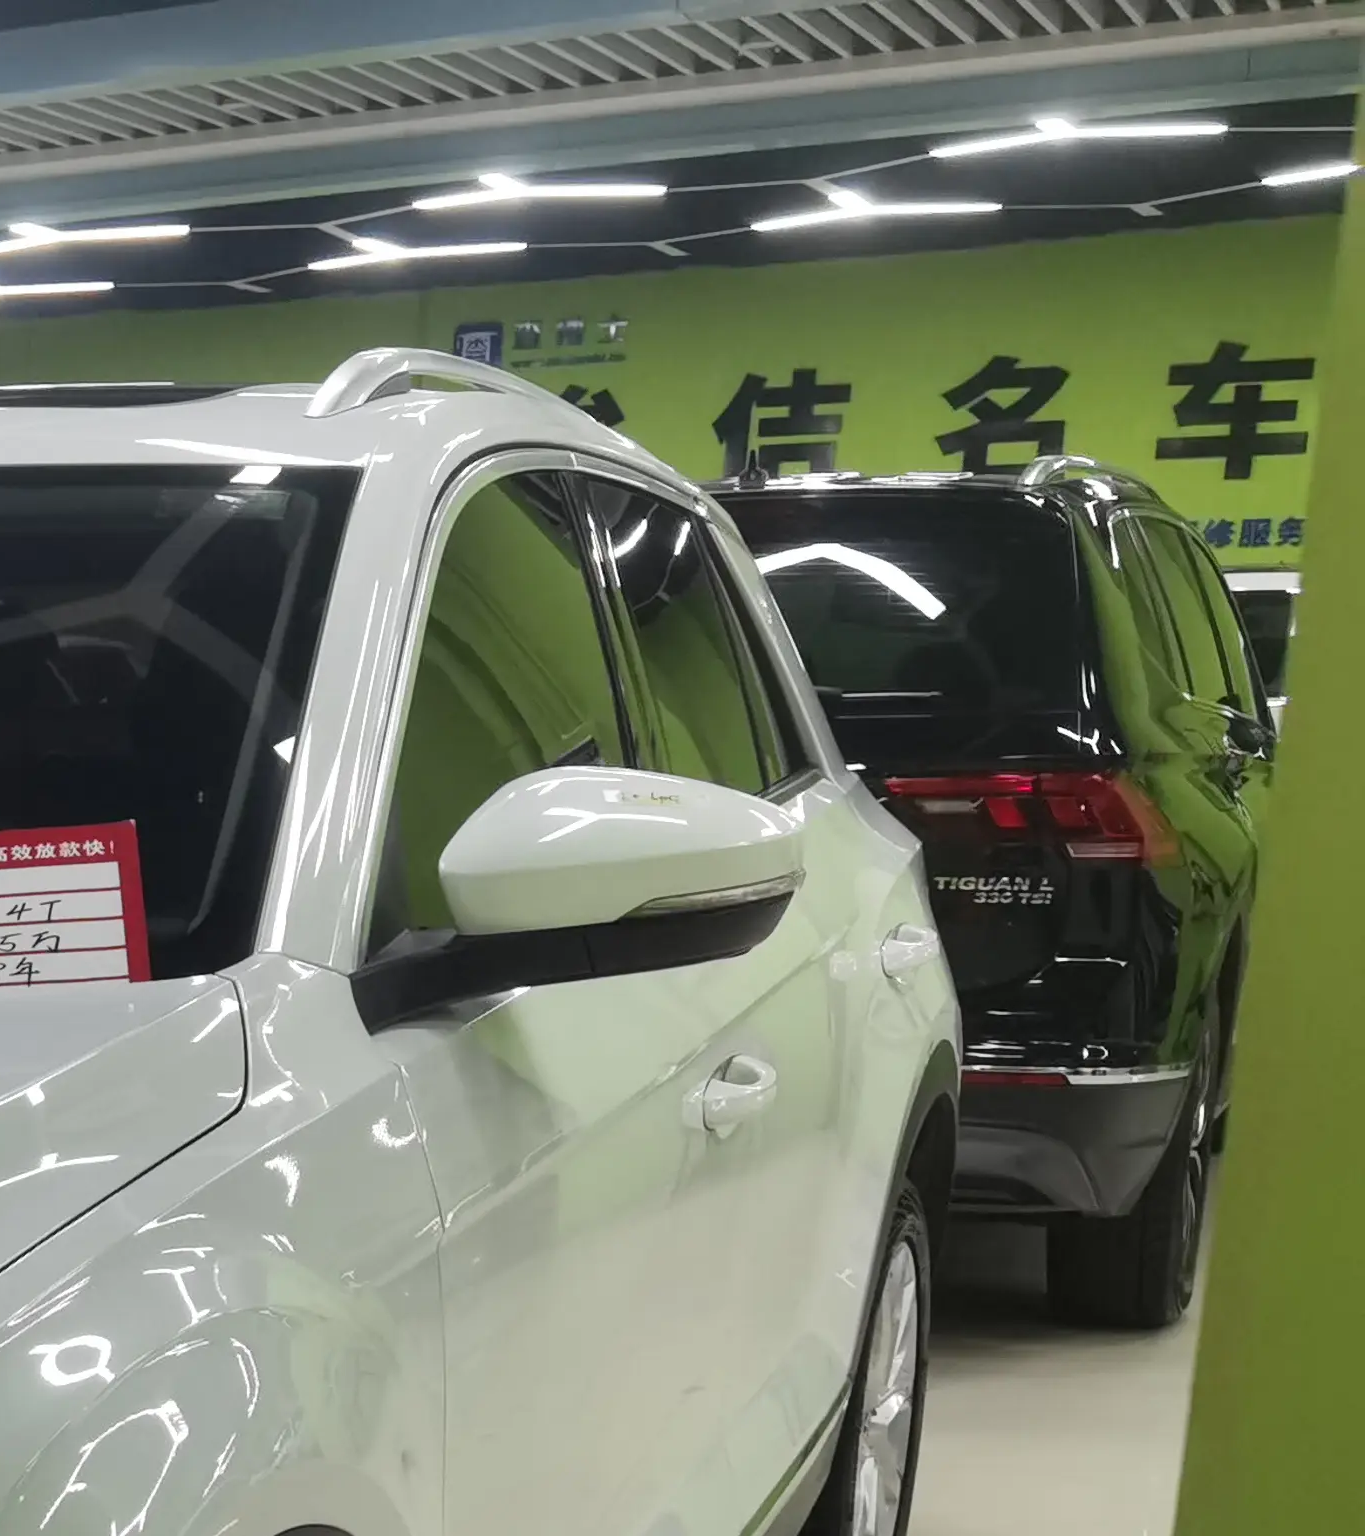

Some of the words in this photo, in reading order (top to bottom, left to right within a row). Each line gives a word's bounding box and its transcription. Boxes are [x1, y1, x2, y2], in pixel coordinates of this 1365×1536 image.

[559, 341, 1316, 481] 信名车
[933, 876, 1031, 891] TIGUAN
[1039, 877, 1055, 892] L
